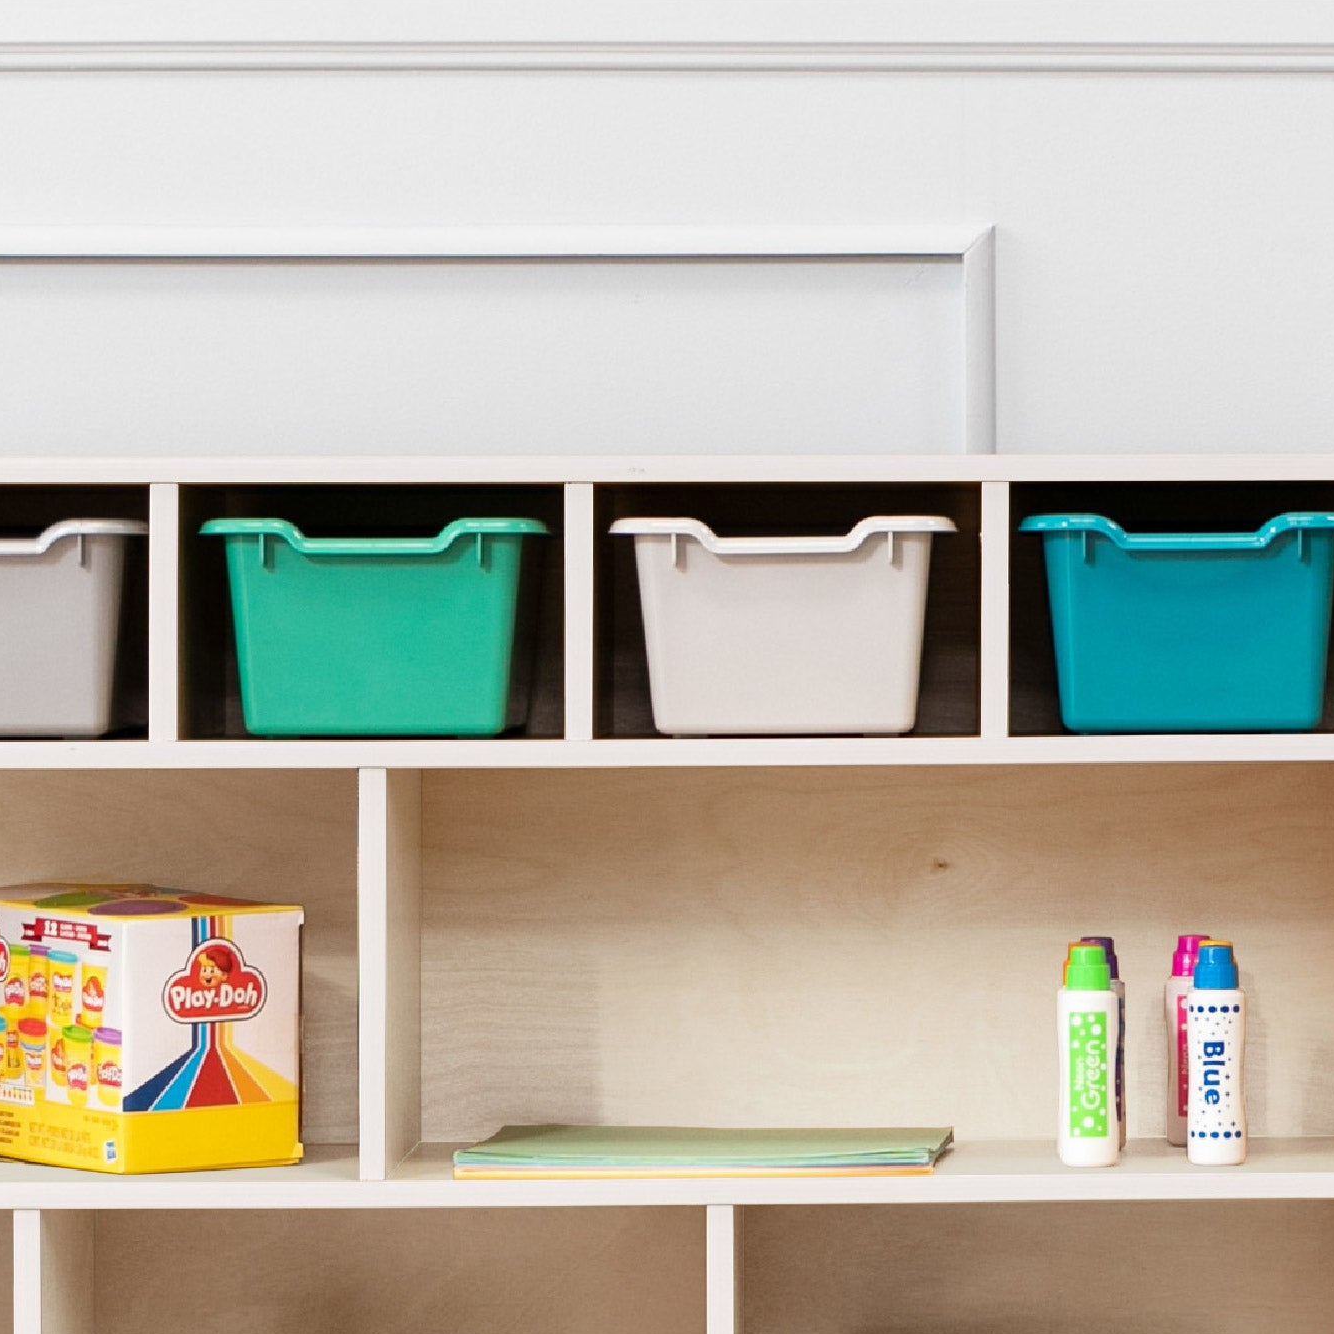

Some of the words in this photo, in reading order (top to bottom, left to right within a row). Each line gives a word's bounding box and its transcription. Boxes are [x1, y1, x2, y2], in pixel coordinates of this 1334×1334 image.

[171, 982, 258, 1009] Play-Doh
[1080, 1038, 1101, 1110] Green
[1203, 1041, 1225, 1105] Blue
